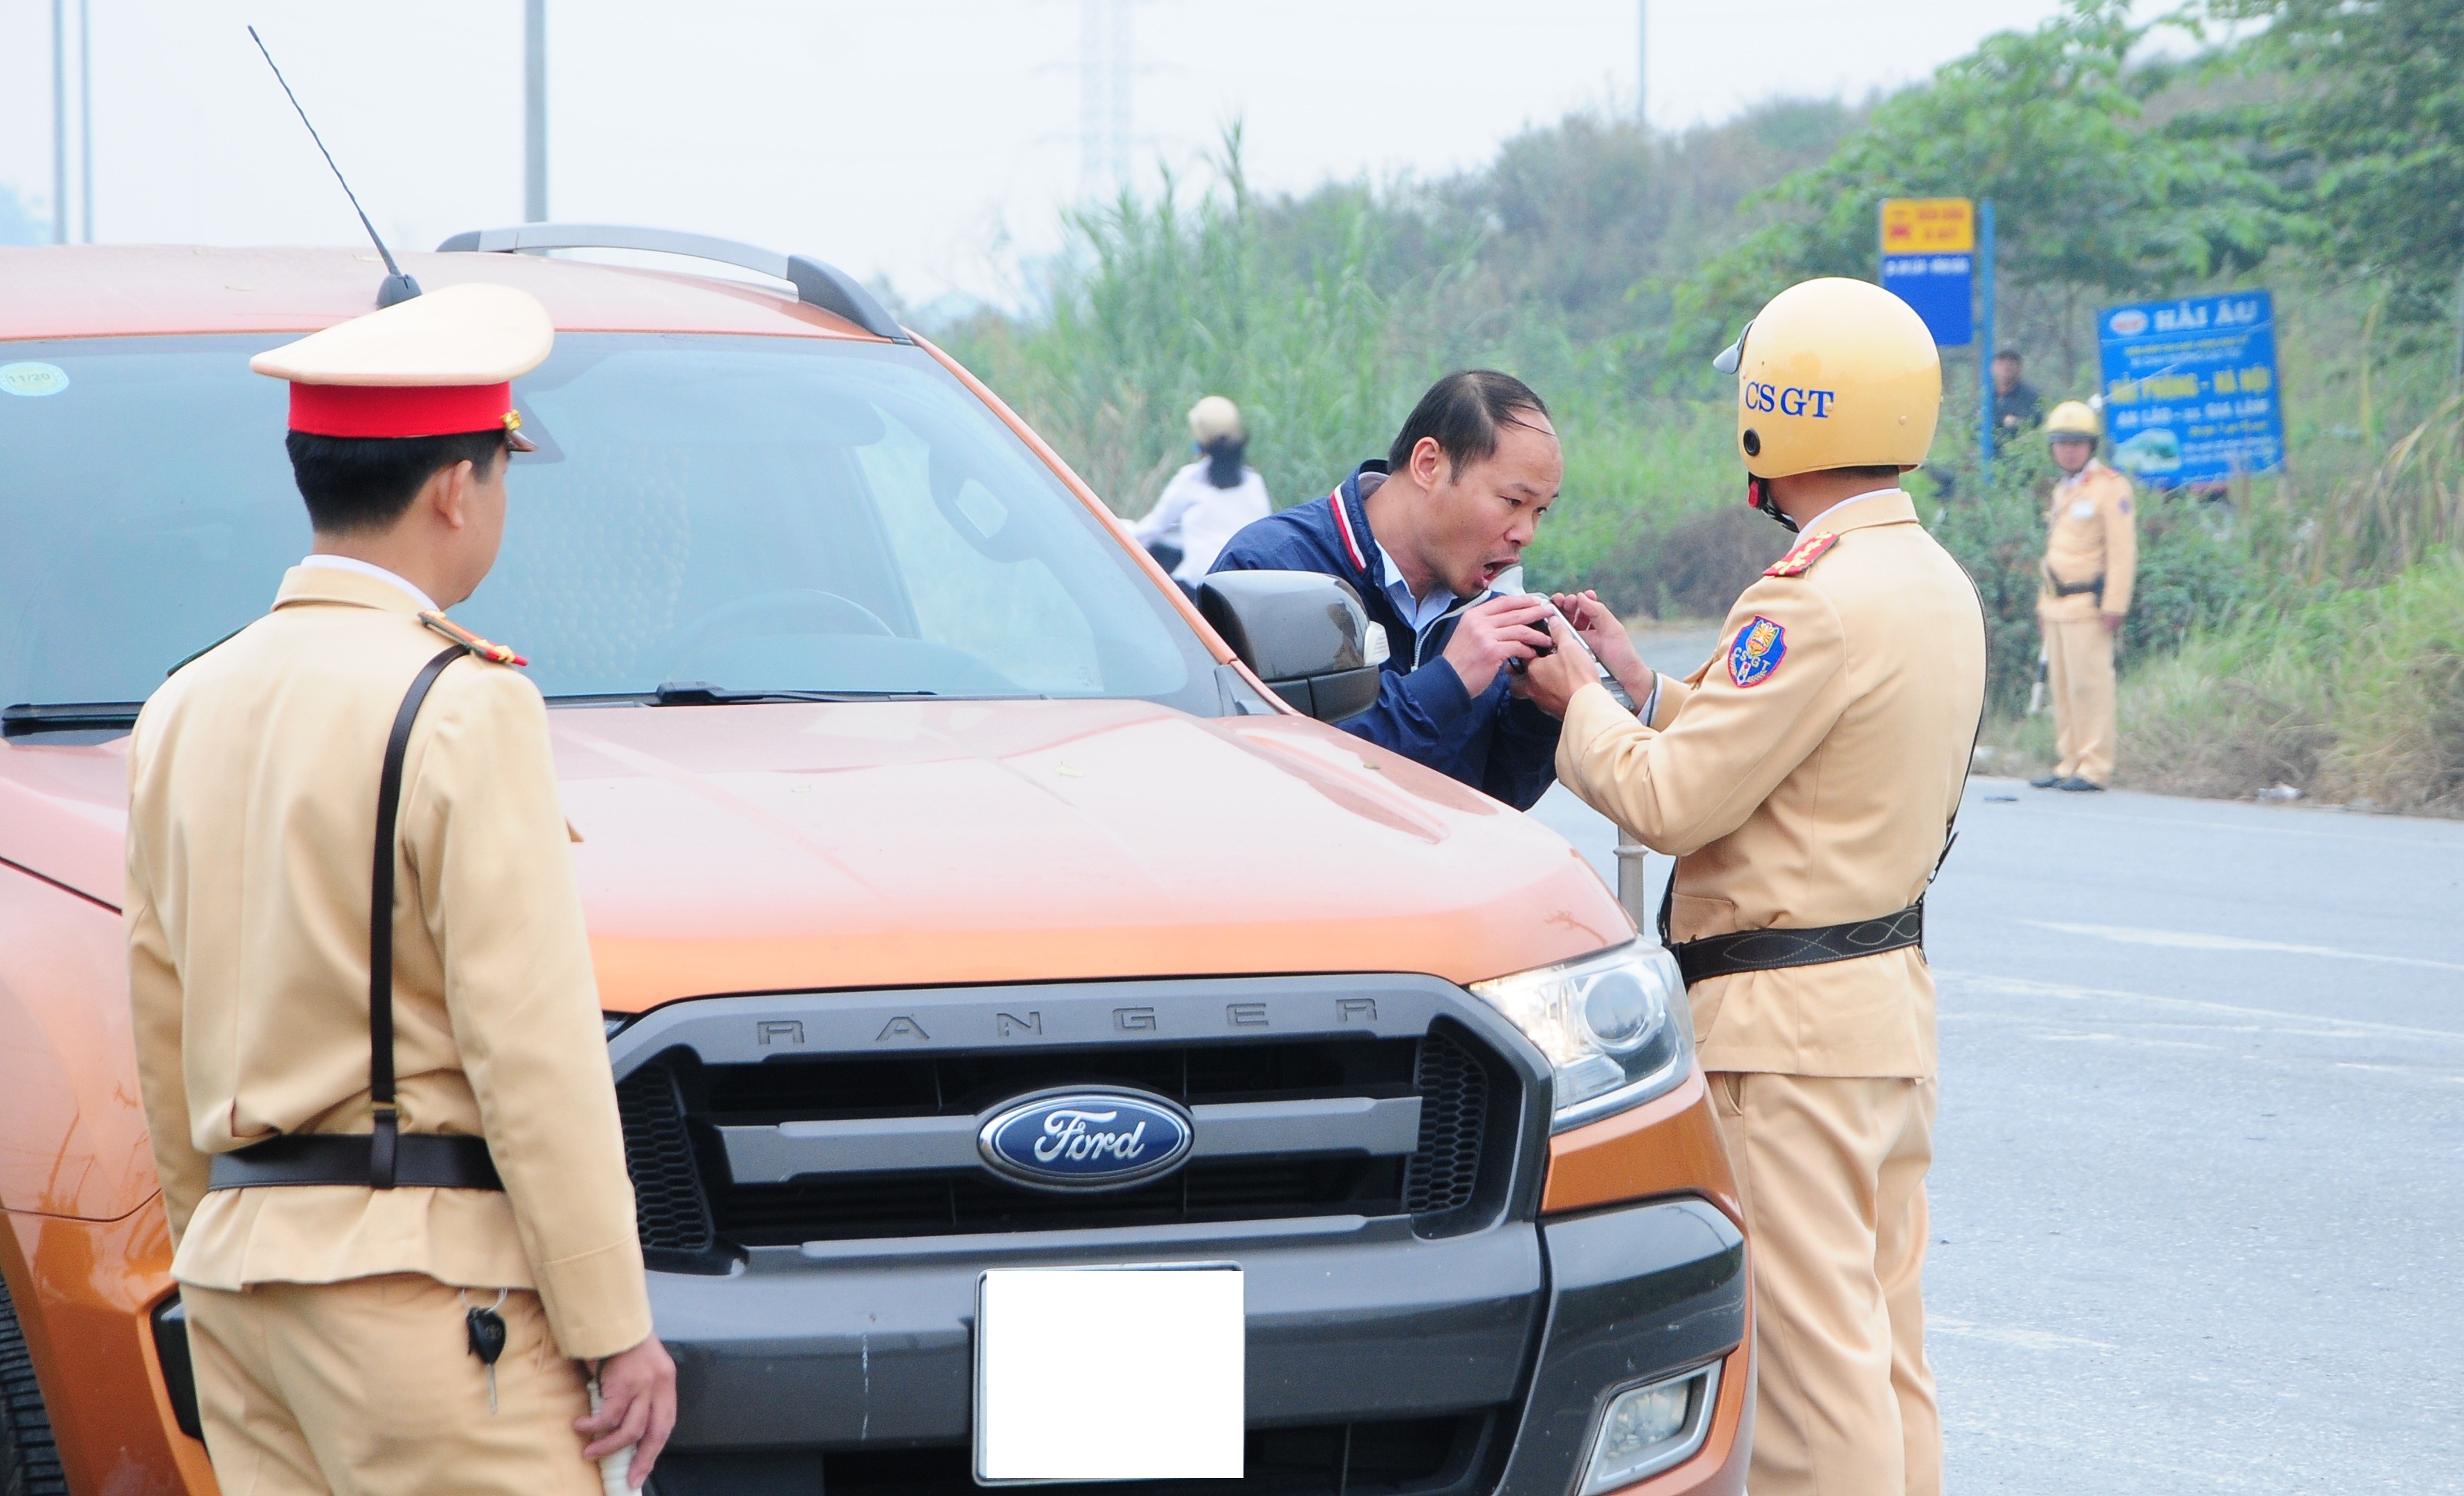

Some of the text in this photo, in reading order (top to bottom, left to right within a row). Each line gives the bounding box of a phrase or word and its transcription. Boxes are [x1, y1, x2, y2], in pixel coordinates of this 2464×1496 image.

[1745, 382, 1835, 418] CSGT
[756, 997, 1379, 1046] RANGER
[1033, 1109, 1146, 1163] Ford
